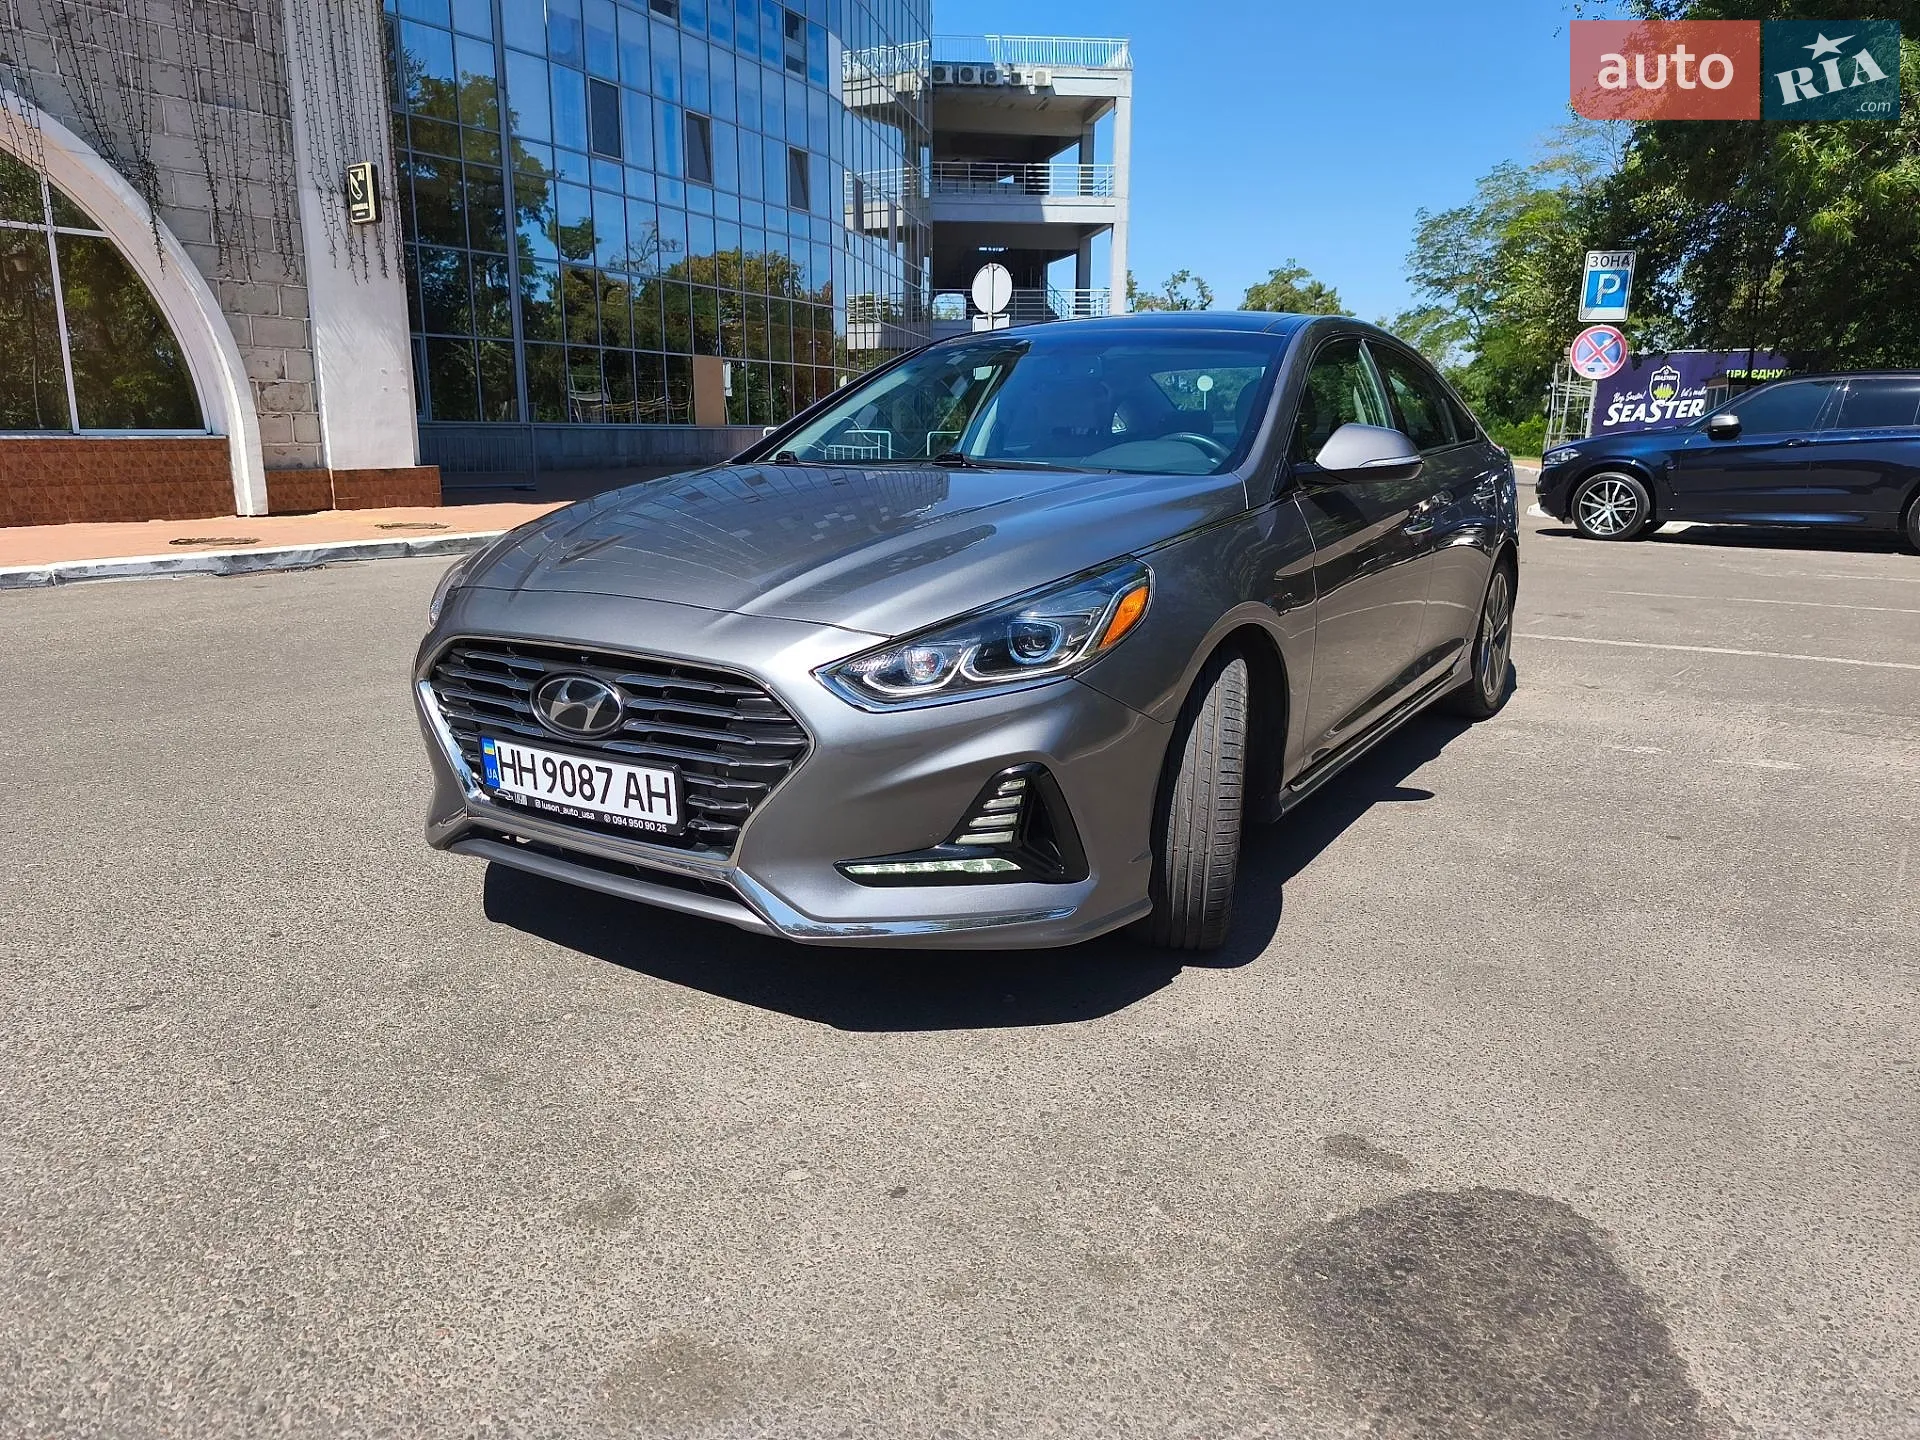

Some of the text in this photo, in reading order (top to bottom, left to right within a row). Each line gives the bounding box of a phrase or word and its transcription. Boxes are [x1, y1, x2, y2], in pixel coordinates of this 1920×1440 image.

[1590, 254, 1631, 268] ЗОНА
[1596, 273, 1620, 305] P
[487, 767, 499, 781] UA
[497, 746, 672, 816] HH 9087 AH
[613, 815, 628, 827] 094
[628, 818, 644, 829] 950
[657, 823, 667, 833] 25
